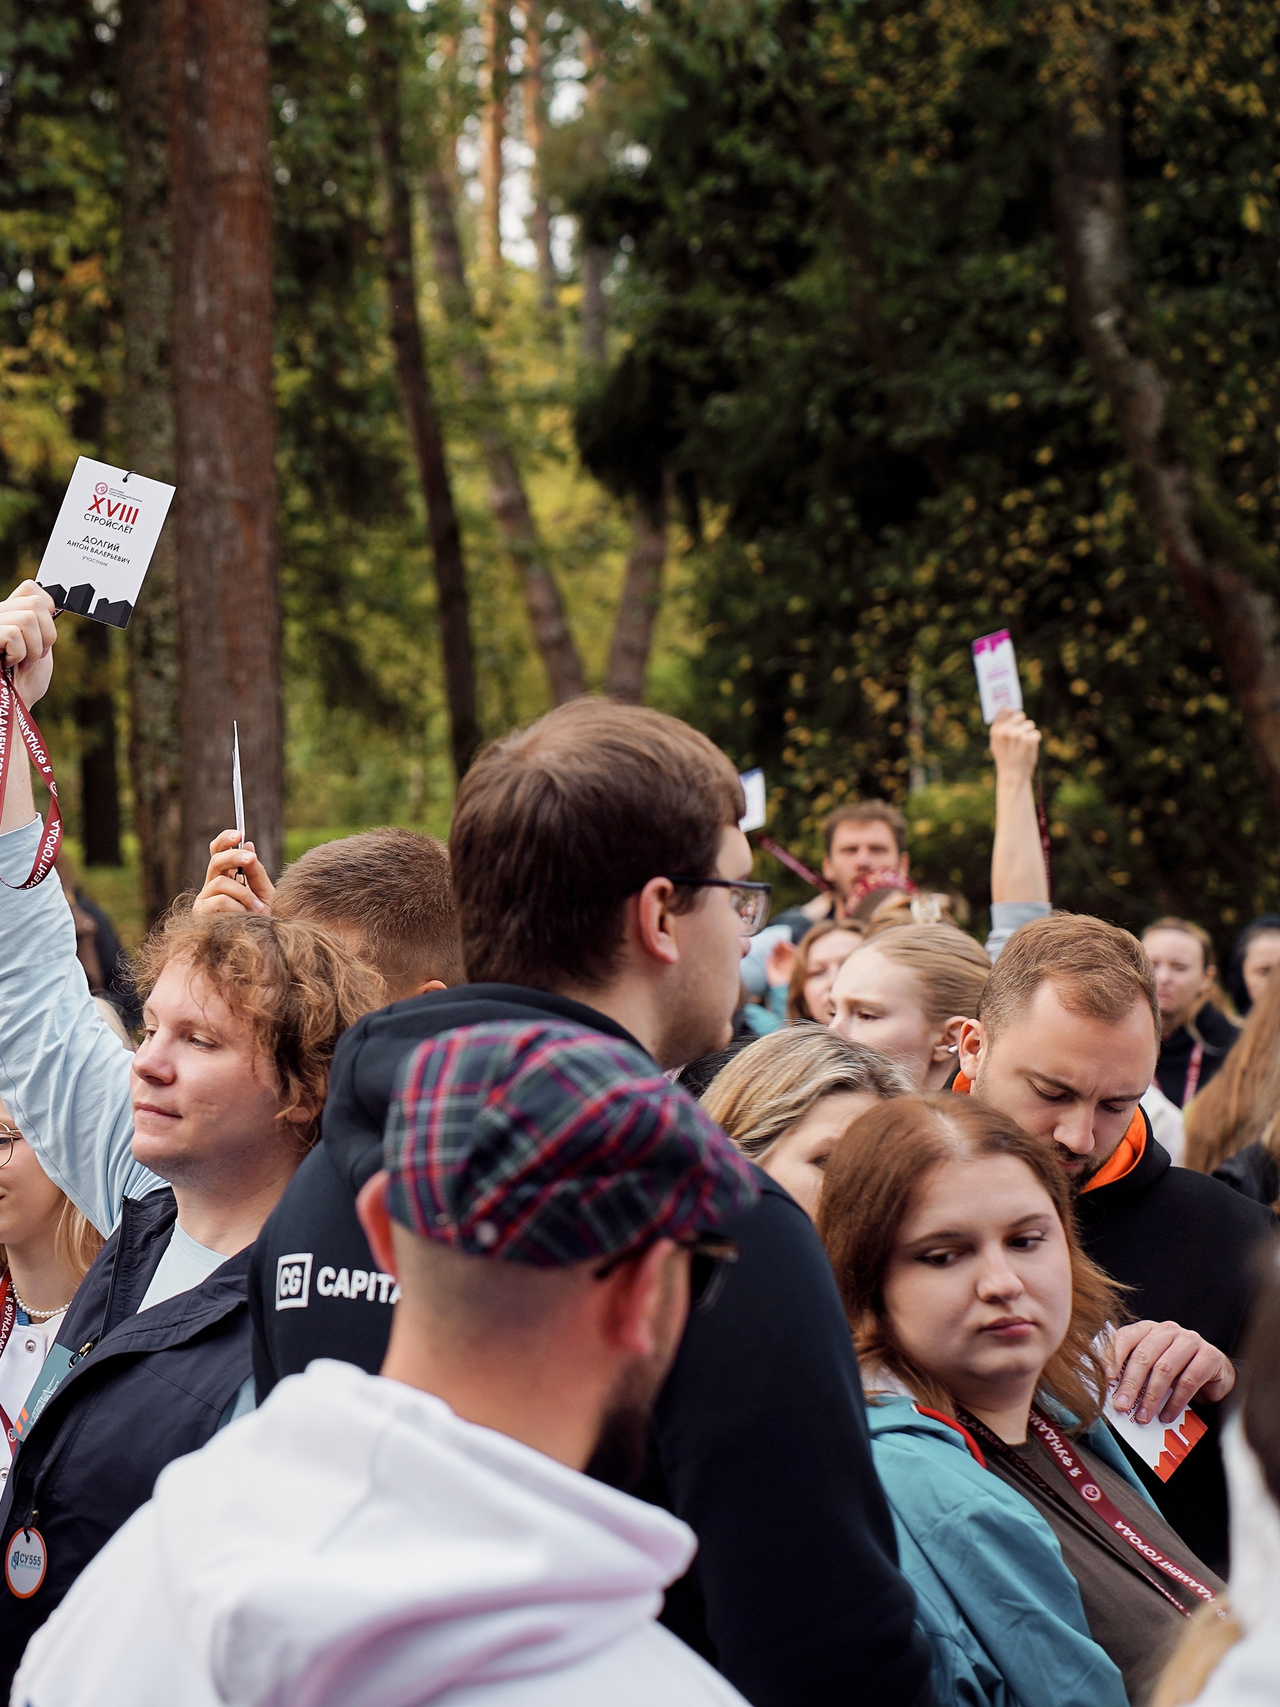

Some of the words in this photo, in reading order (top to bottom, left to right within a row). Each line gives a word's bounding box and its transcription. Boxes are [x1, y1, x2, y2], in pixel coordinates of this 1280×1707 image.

[87, 494, 140, 525] XVIII
[83, 513, 134, 535] СТРОЙСЛЁТ
[66, 540, 89, 552] АНТОН
[82, 535, 120, 552] ДОЛГИЙ
[42, 765, 53, 773] Я
[42, 819, 61, 867] ГОРОДА
[1069, 1468, 1082, 1477] Я
[1115, 1520, 1163, 1562] ГОРОДА
